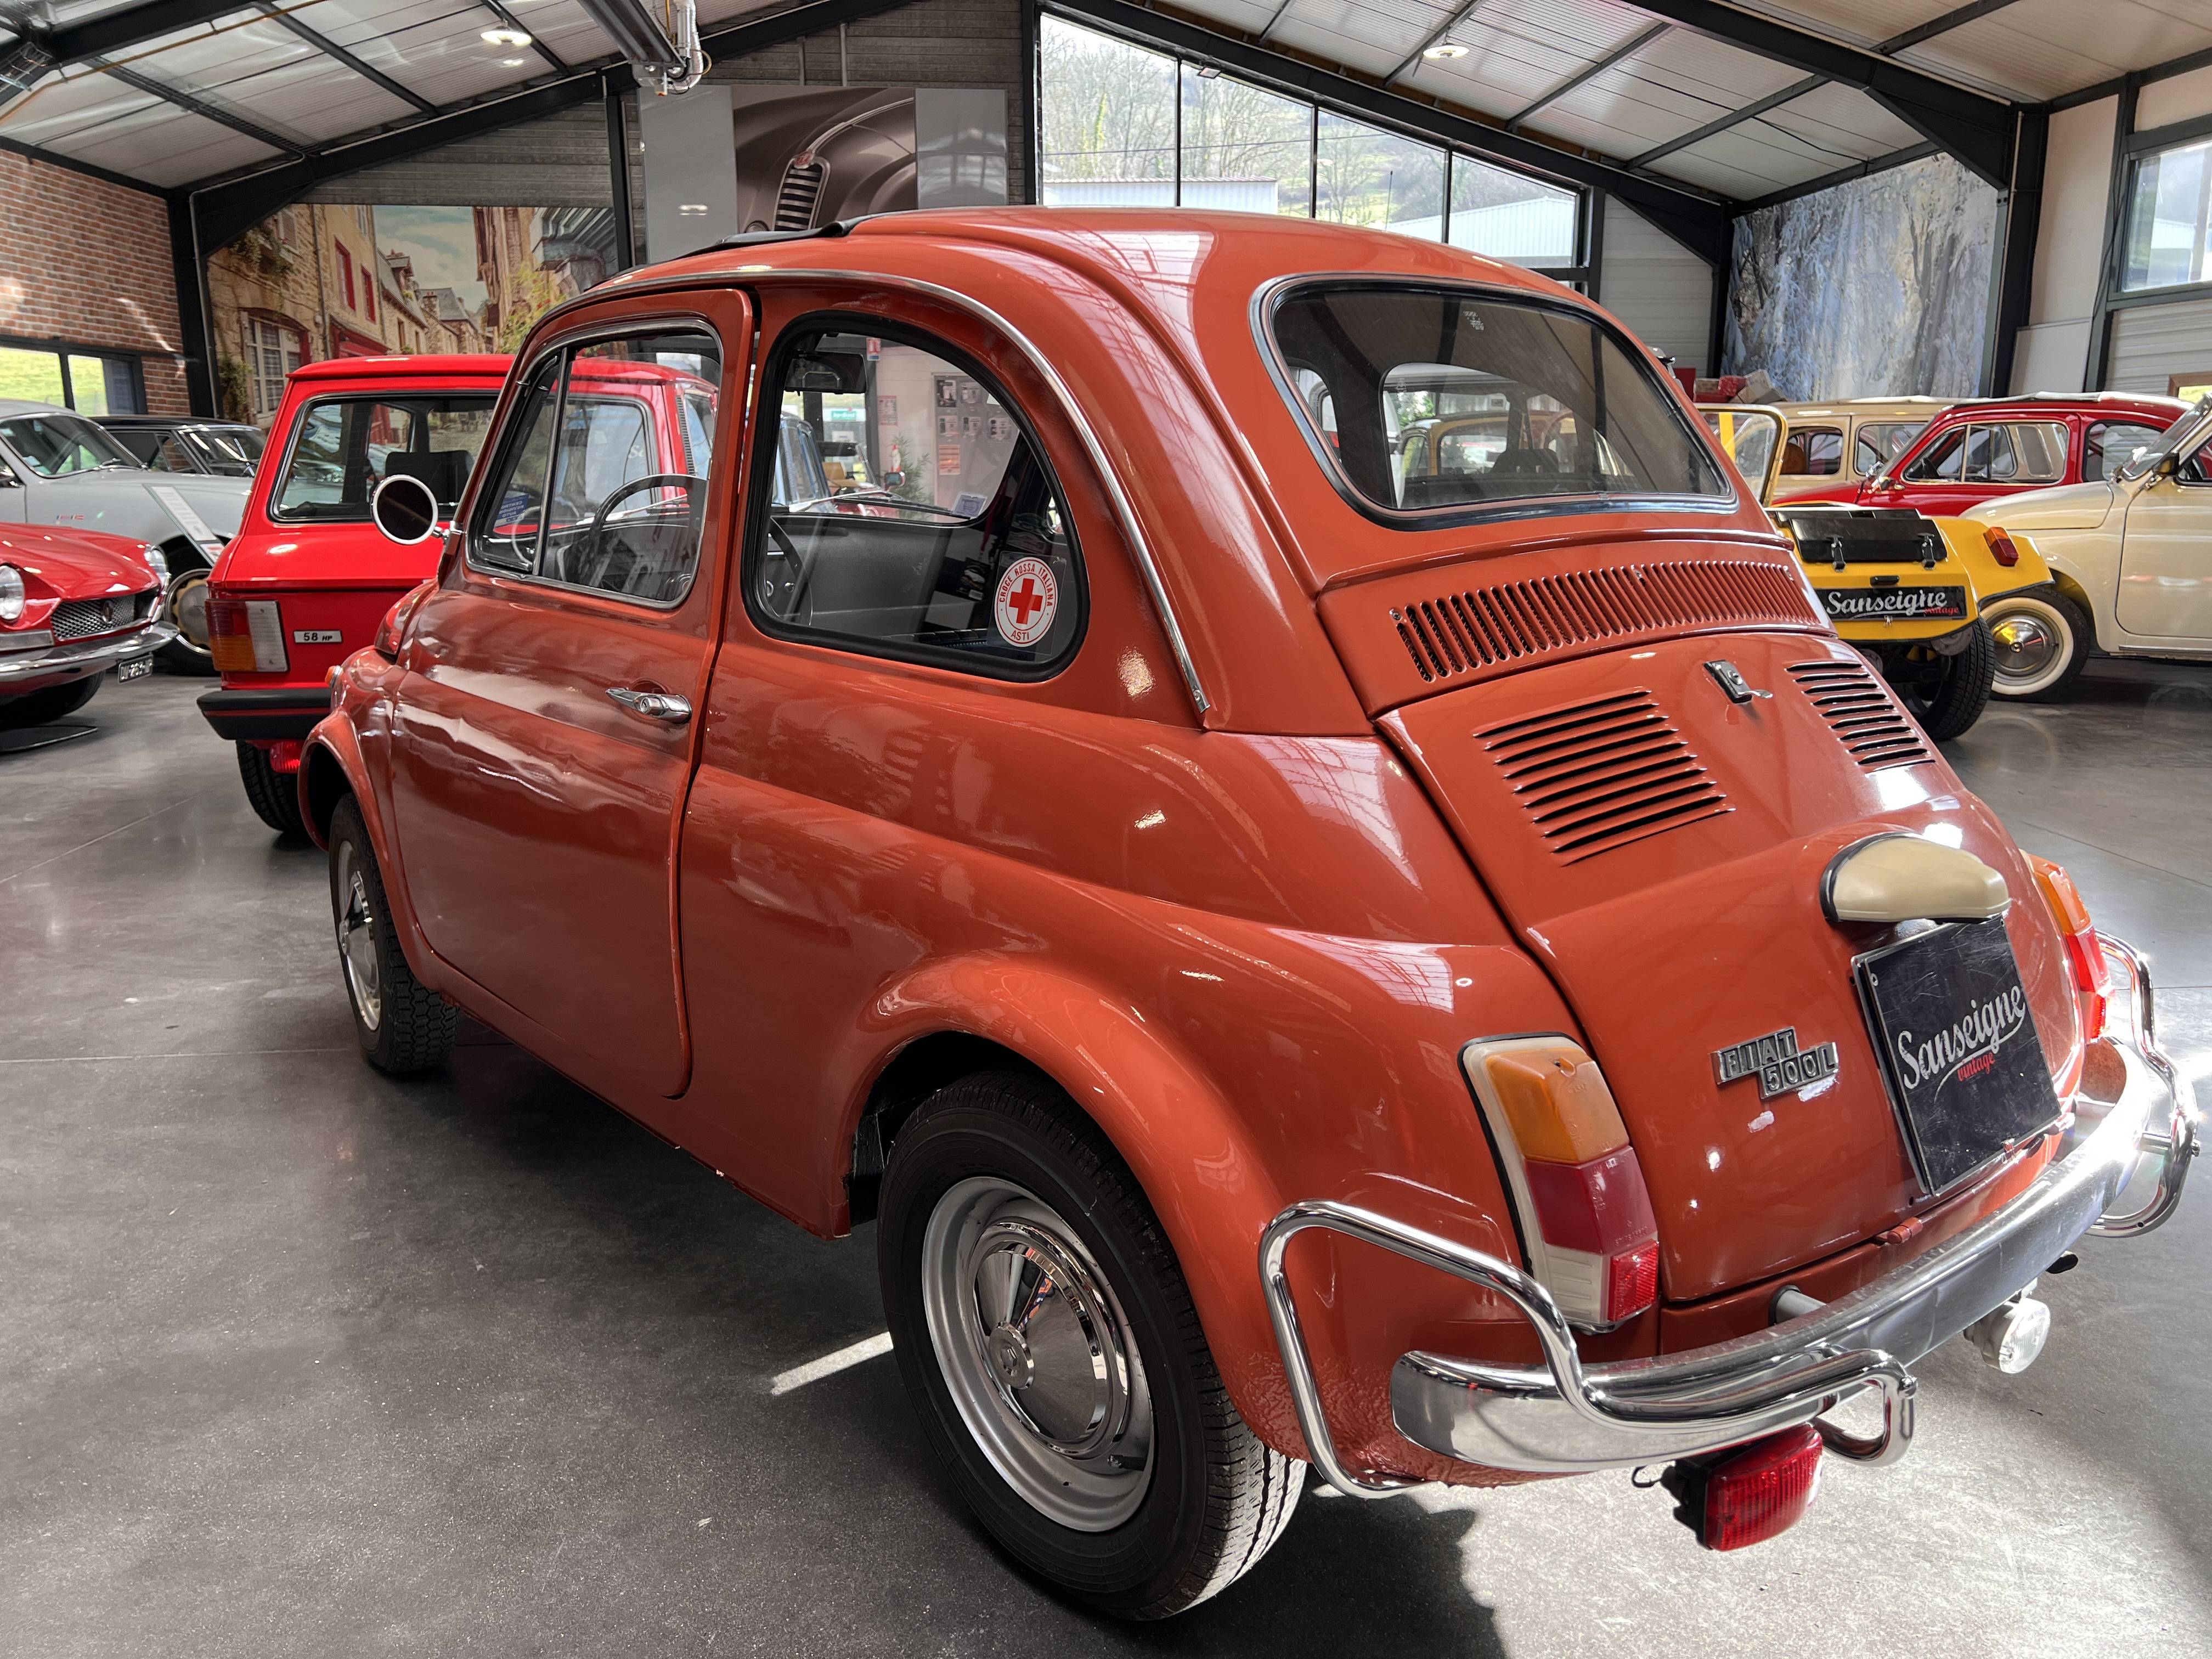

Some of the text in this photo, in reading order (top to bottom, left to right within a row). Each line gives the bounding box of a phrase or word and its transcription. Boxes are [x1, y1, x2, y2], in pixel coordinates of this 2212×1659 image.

[999, 575, 1013, 602] CROCE
[1014, 563, 1036, 576] ROSSA
[1038, 567, 1054, 607] ITALIANA
[1826, 589, 1948, 617] Sanseigne
[303, 632, 318, 641] 58
[1011, 630, 1029, 641] ASTI
[1724, 1031, 1793, 1077] FIAT
[1898, 985, 2025, 1090] Sanseigne
[1765, 1047, 1835, 1091] 500L
[1957, 1052, 1996, 1082] vintage
